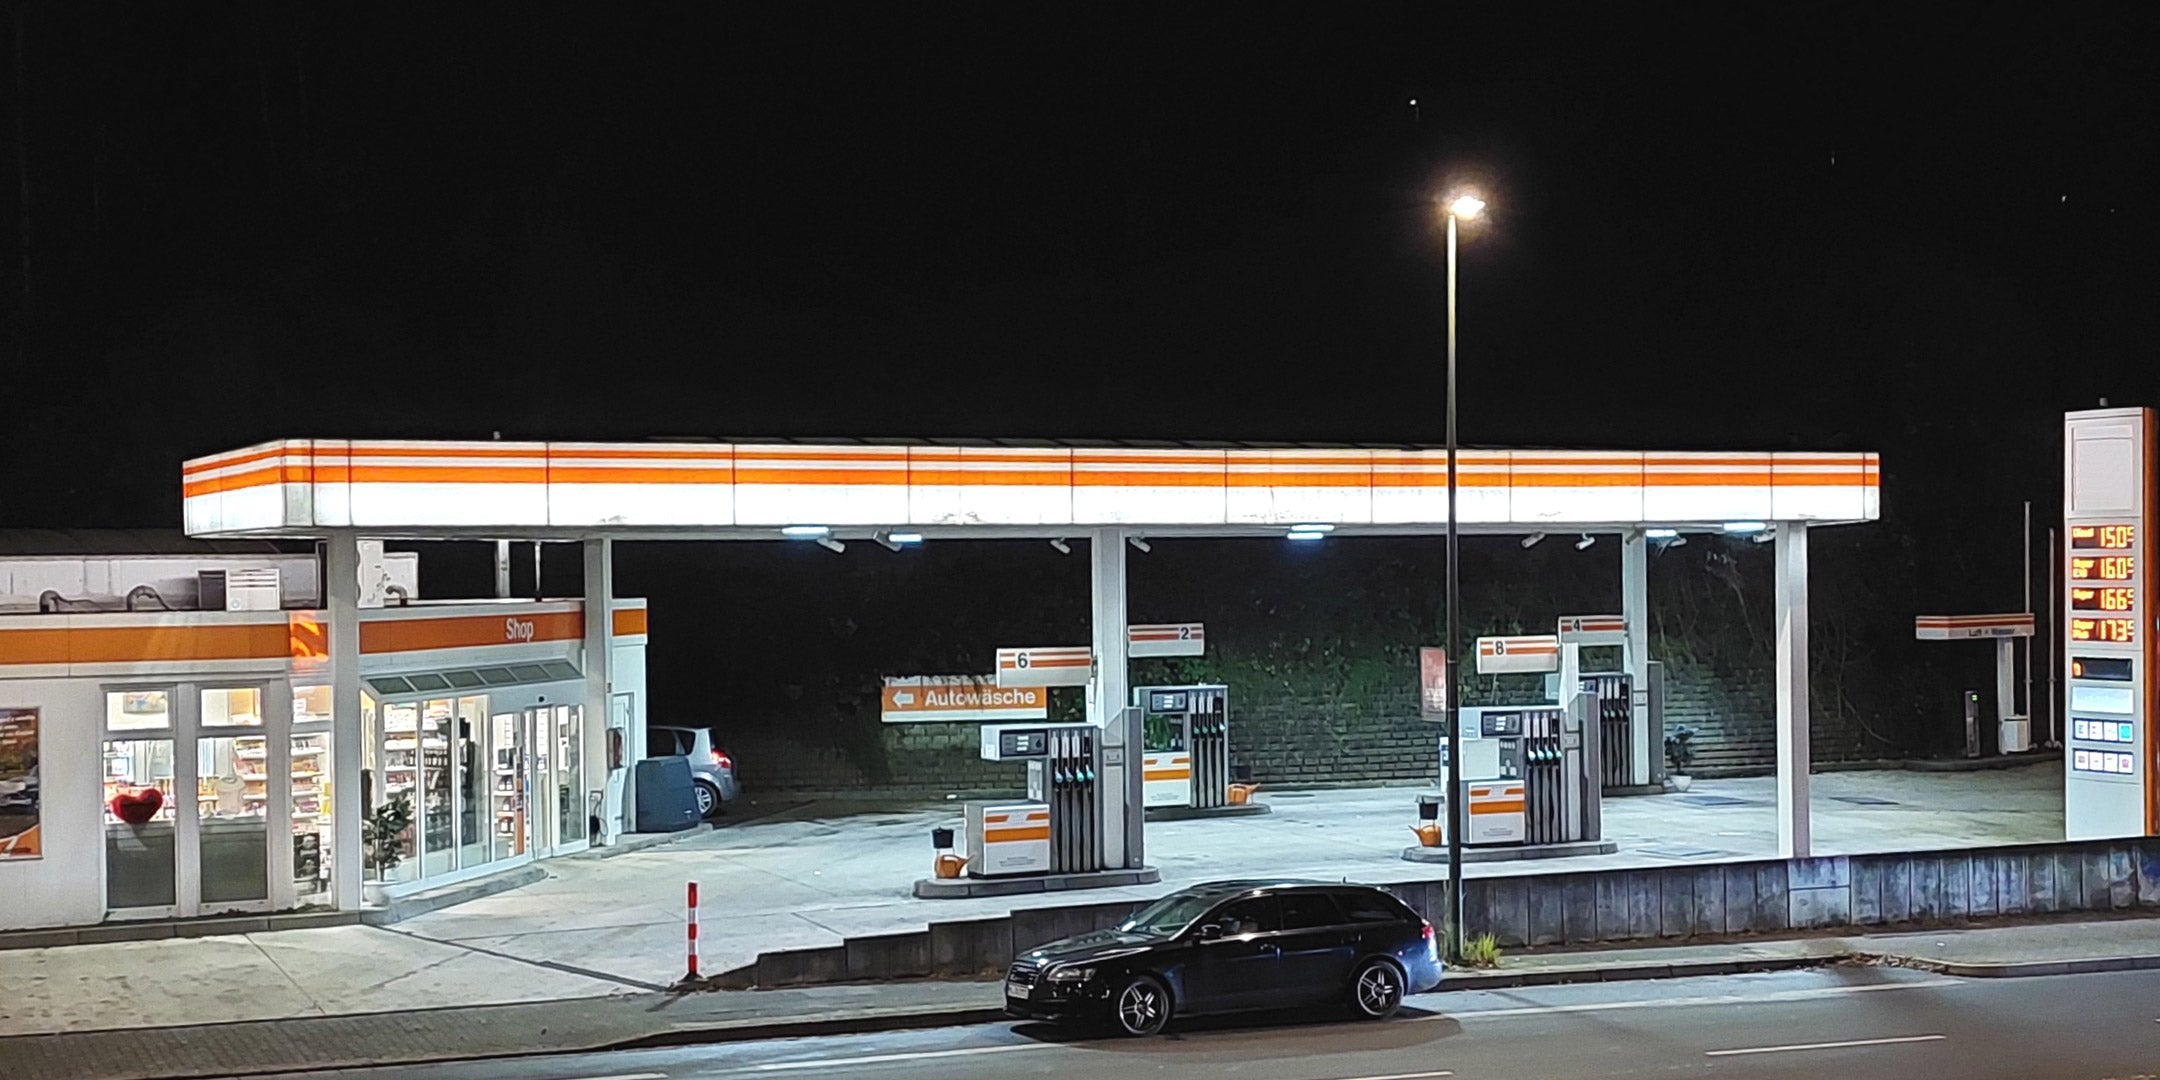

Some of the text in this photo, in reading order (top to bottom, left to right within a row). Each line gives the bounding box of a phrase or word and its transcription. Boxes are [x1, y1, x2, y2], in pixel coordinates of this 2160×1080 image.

[506, 617, 534, 643] Shop
[1572, 619, 1581, 631] 4
[1180, 627, 1190, 640] 2
[1495, 641, 1505, 656] 8
[1017, 652, 1028, 668] 6
[925, 689, 1036, 708] Autowäsche
